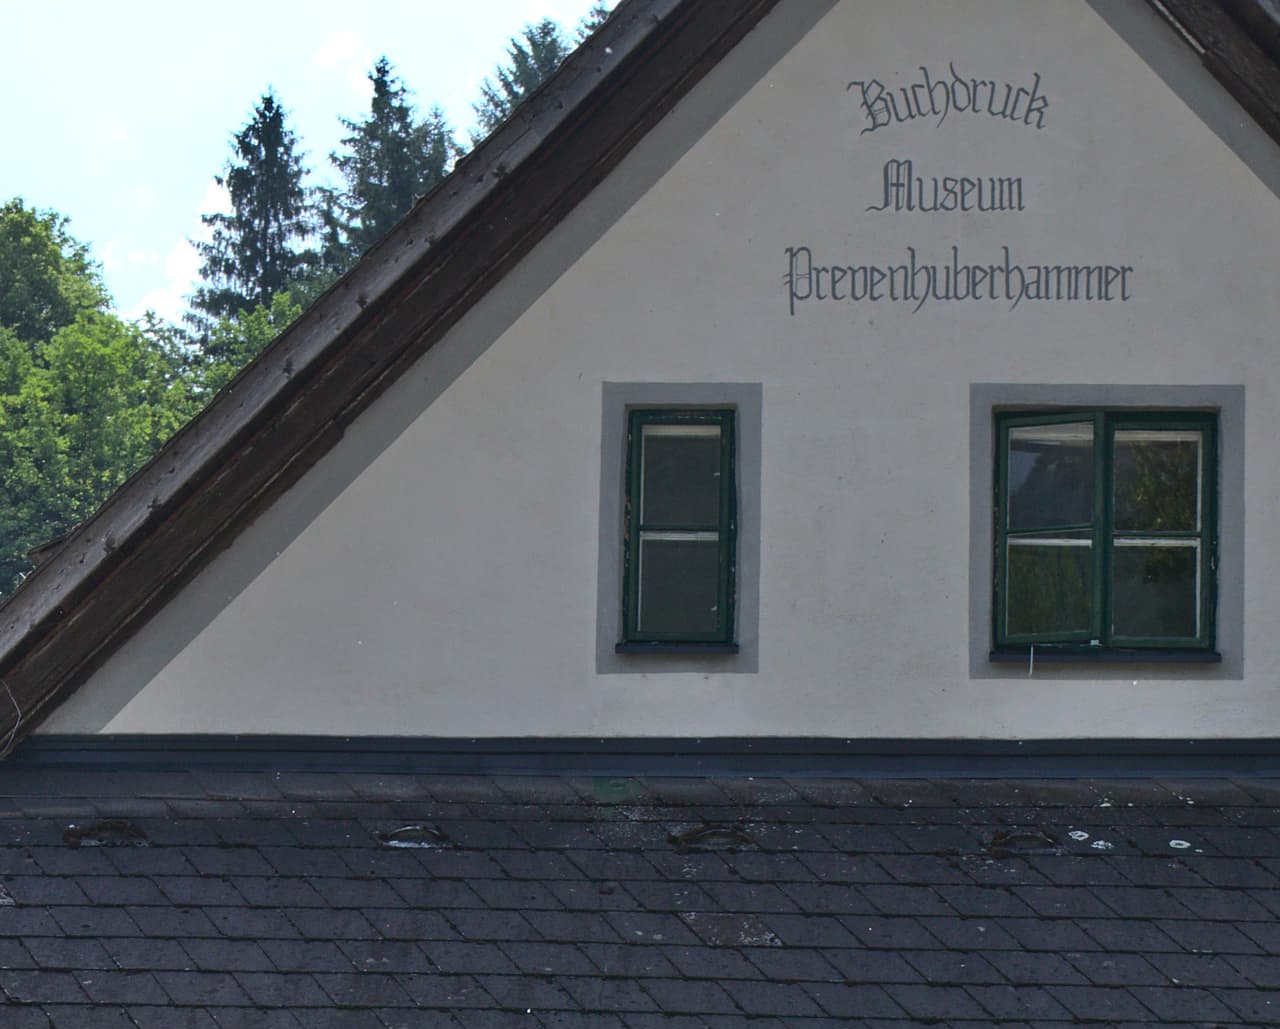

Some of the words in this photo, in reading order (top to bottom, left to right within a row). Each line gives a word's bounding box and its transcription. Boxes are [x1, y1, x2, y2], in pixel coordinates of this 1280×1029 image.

[846, 61, 1049, 137] Buchdruck
[865, 158, 1026, 212] Museum
[783, 245, 1134, 316] Prevenhuberhammer
